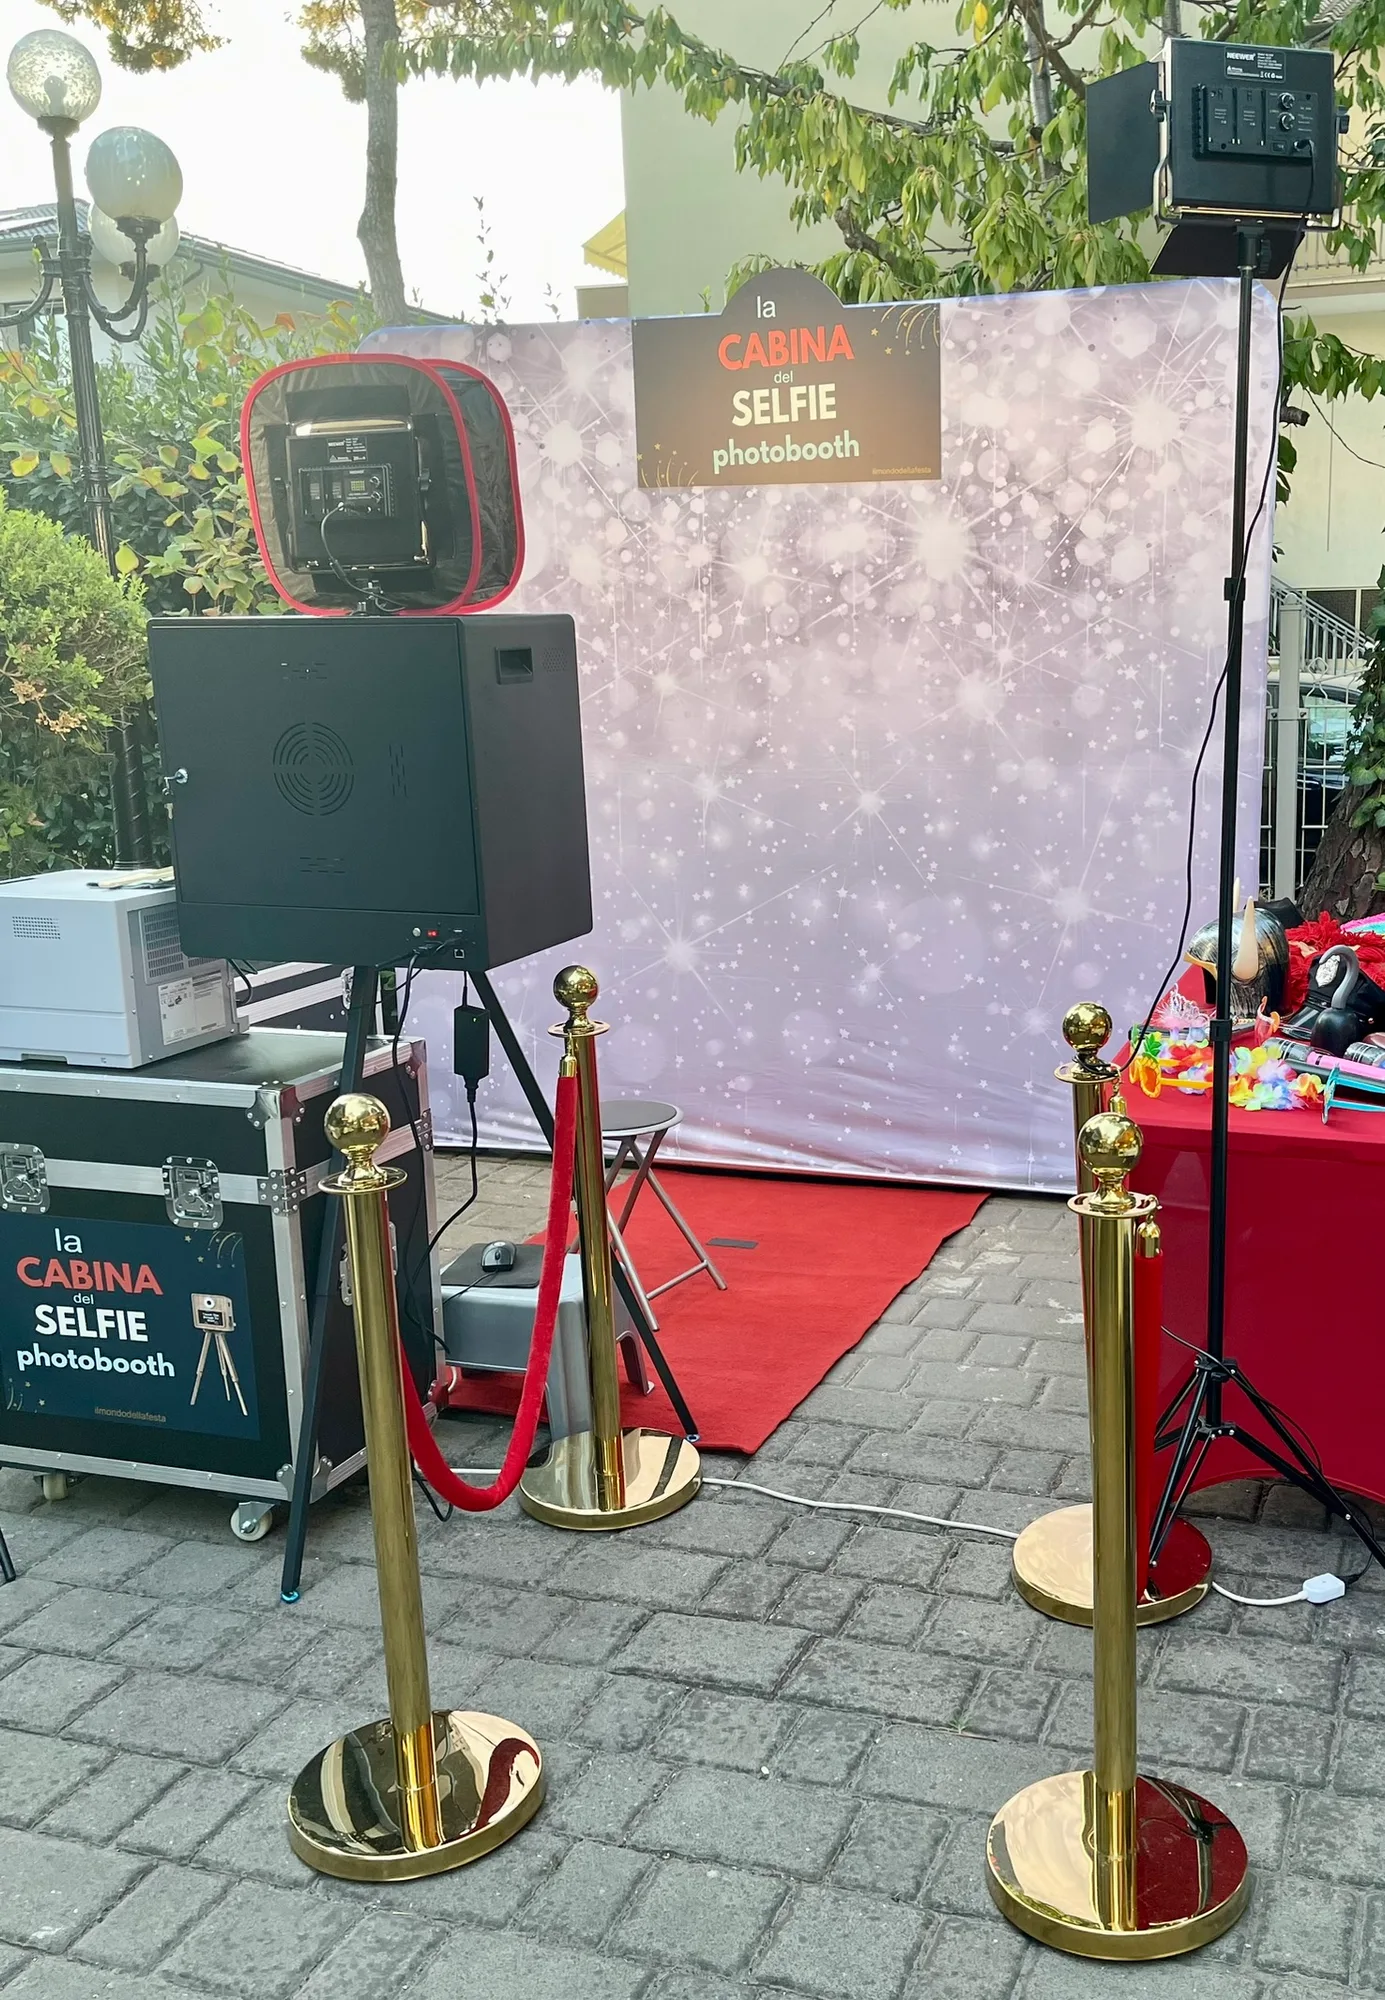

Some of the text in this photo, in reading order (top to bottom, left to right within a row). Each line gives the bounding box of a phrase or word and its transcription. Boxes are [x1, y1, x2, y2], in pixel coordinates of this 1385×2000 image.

[756, 295, 776, 319] la
[717, 323, 855, 371] CABINA
[773, 370, 794, 384] del
[731, 383, 837, 427] SELFIE
[713, 430, 860, 475] photobooth
[54, 1227, 83, 1254] la
[16, 1256, 164, 1296] CABINA
[73, 1292, 94, 1305] del
[35, 1303, 149, 1343] SELFIE
[16, 1343, 176, 1377] photobooth
[94, 1406, 167, 1423] ilmondodellafesta
